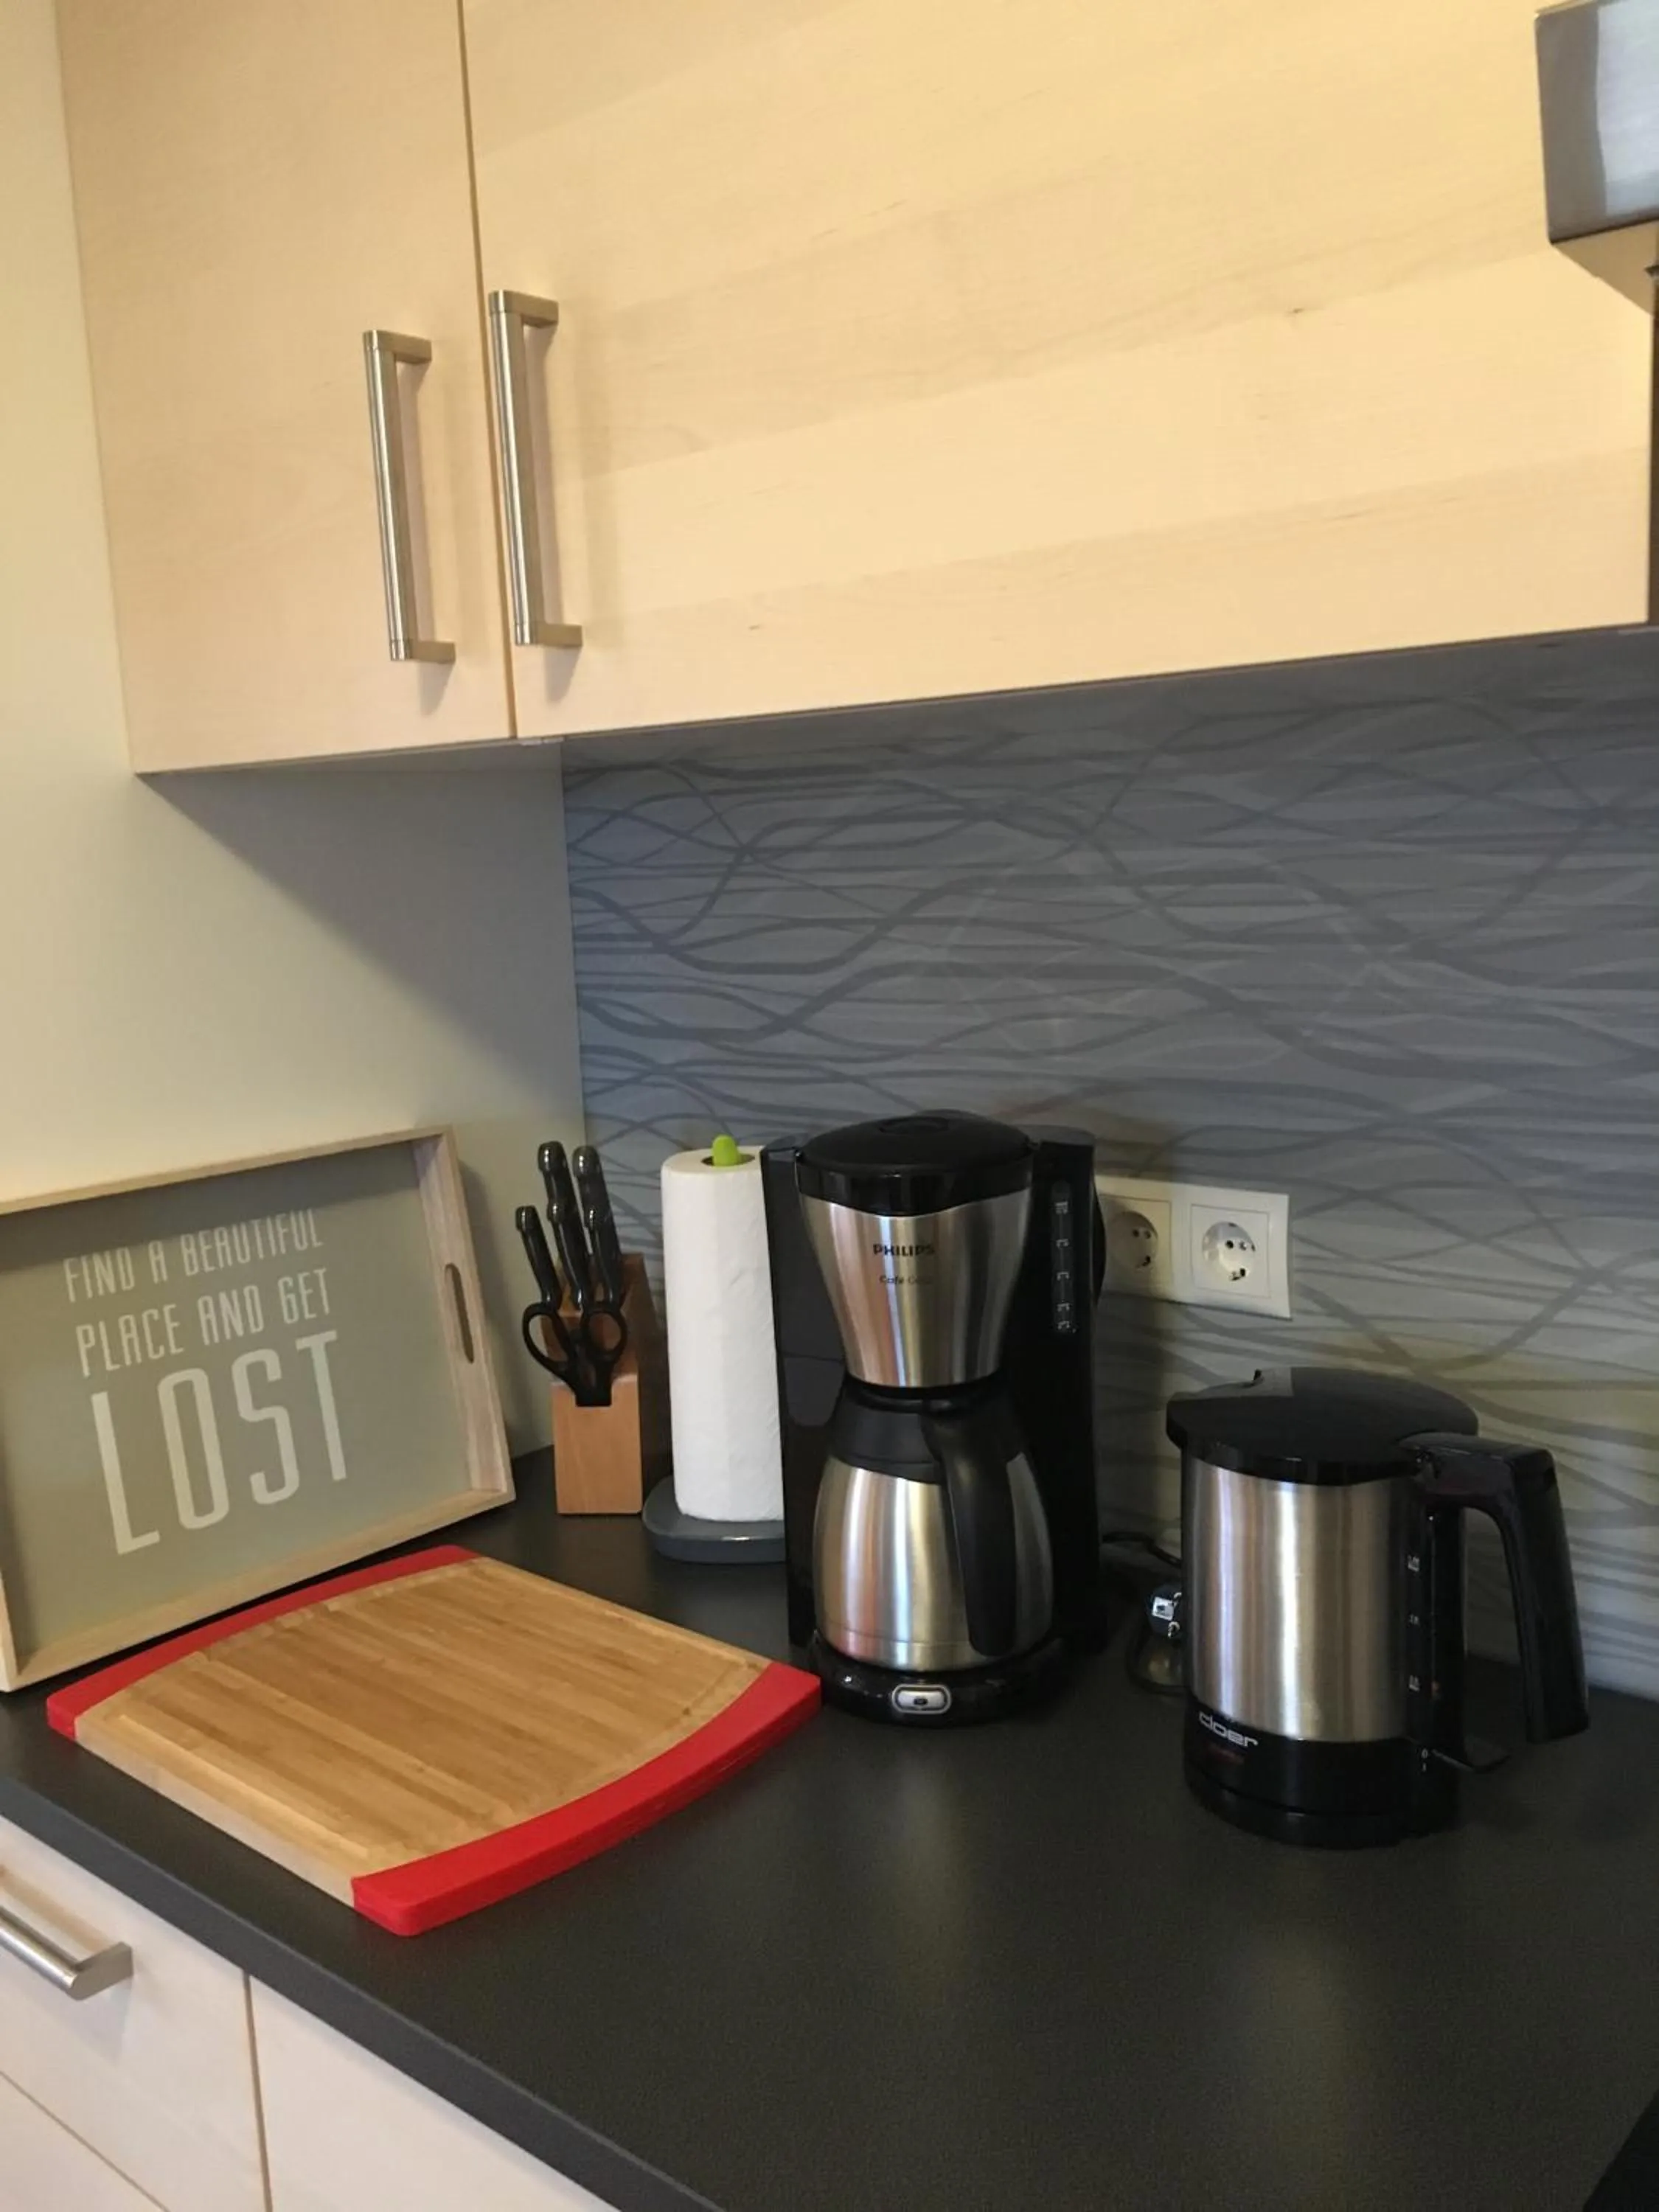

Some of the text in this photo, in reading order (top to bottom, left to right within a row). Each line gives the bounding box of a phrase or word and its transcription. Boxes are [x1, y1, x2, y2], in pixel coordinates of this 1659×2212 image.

[63, 1208, 324, 1303] FIND A BEAUTIFUL
[873, 1243, 935, 1256] PHILIPS
[75, 1267, 332, 1378] PLACE AND GET
[91, 1329, 347, 1555] LOST
